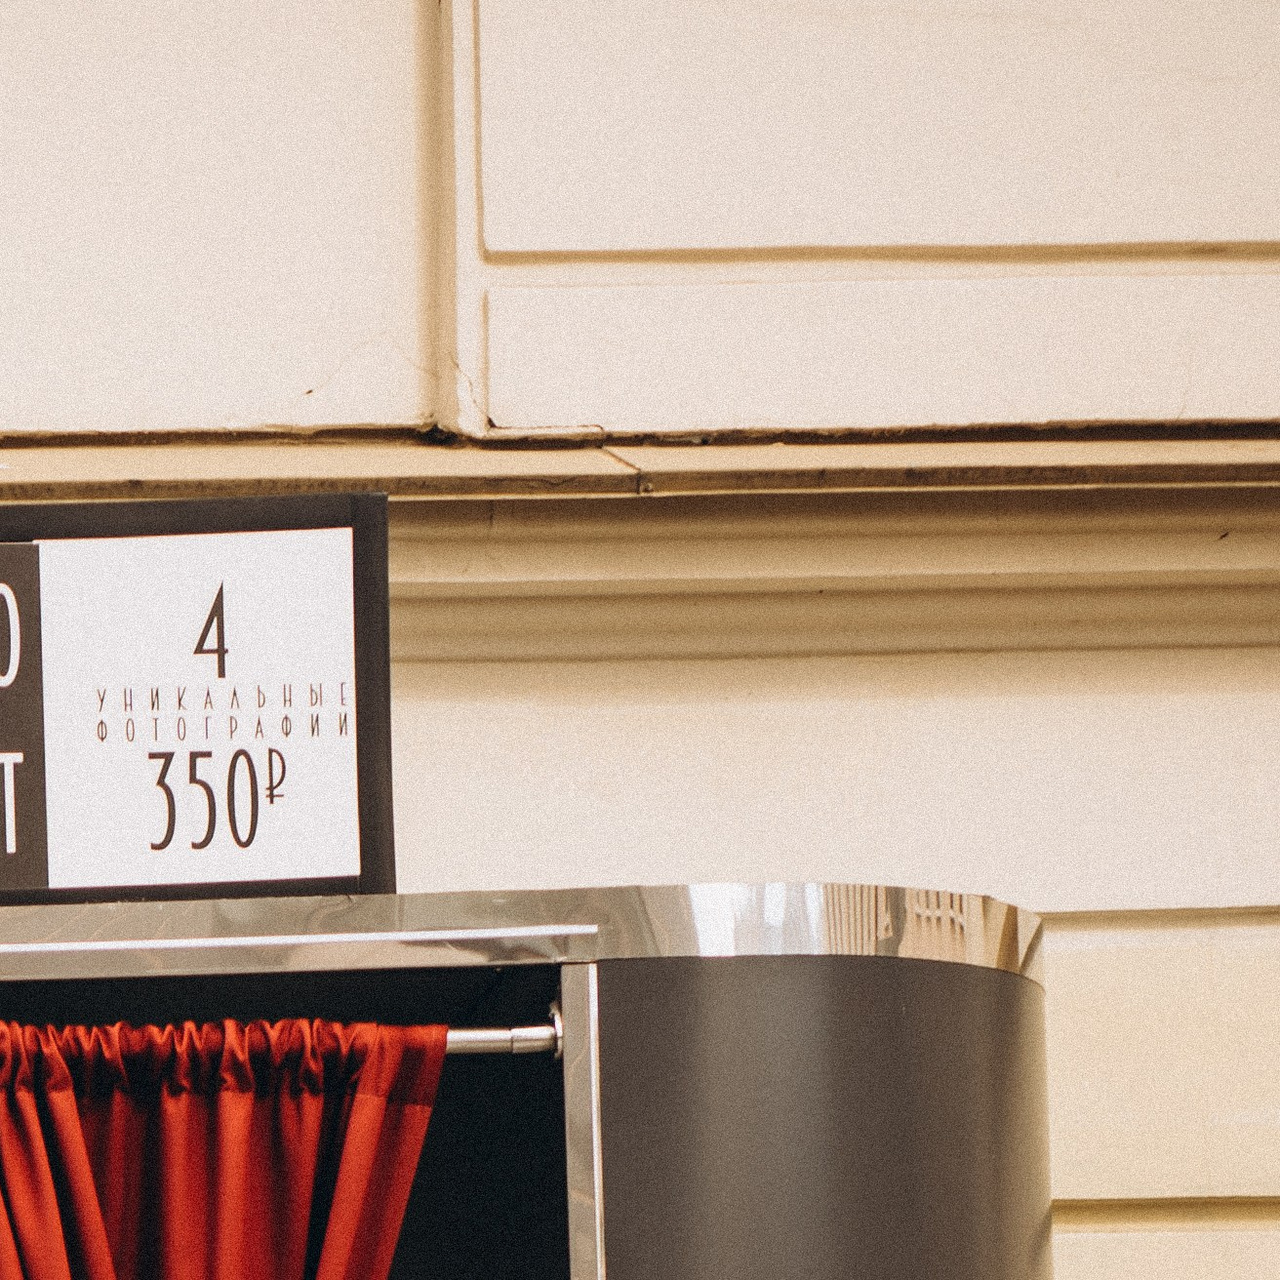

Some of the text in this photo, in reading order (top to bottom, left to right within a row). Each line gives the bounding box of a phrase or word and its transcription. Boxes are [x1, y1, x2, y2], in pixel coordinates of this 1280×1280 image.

[194, 581, 228, 678] 4
[97, 682, 347, 713] УНИКАЛЬНЫЕ
[96, 712, 349, 743] ФОТОГРАФИИ
